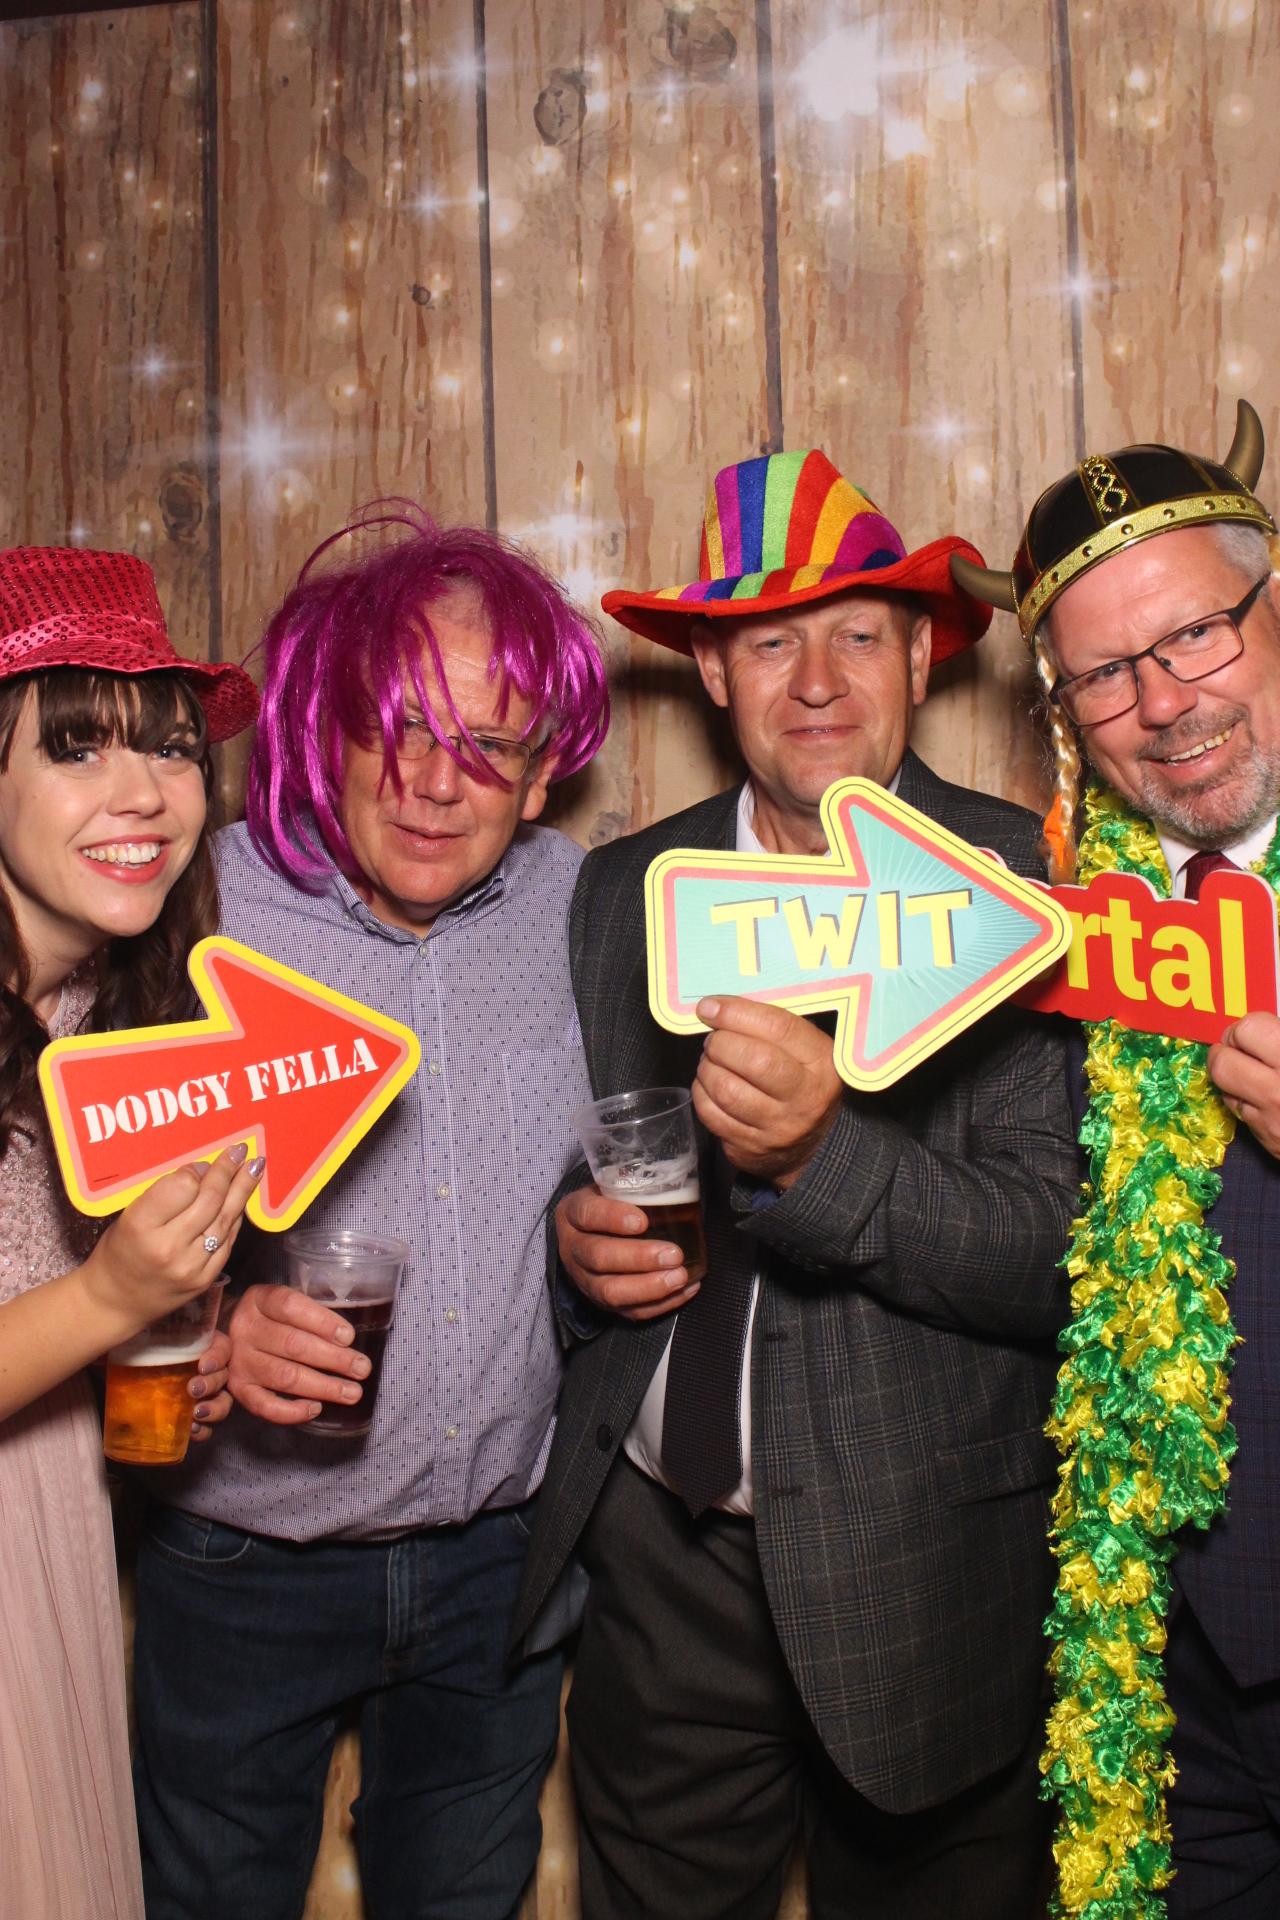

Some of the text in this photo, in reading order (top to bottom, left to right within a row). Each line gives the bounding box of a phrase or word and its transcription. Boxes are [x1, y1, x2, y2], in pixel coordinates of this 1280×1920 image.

[710, 888, 972, 976] TWIT
[1030, 897, 1248, 1018] rtal
[81, 1037, 379, 1143] DODGY FELLA
